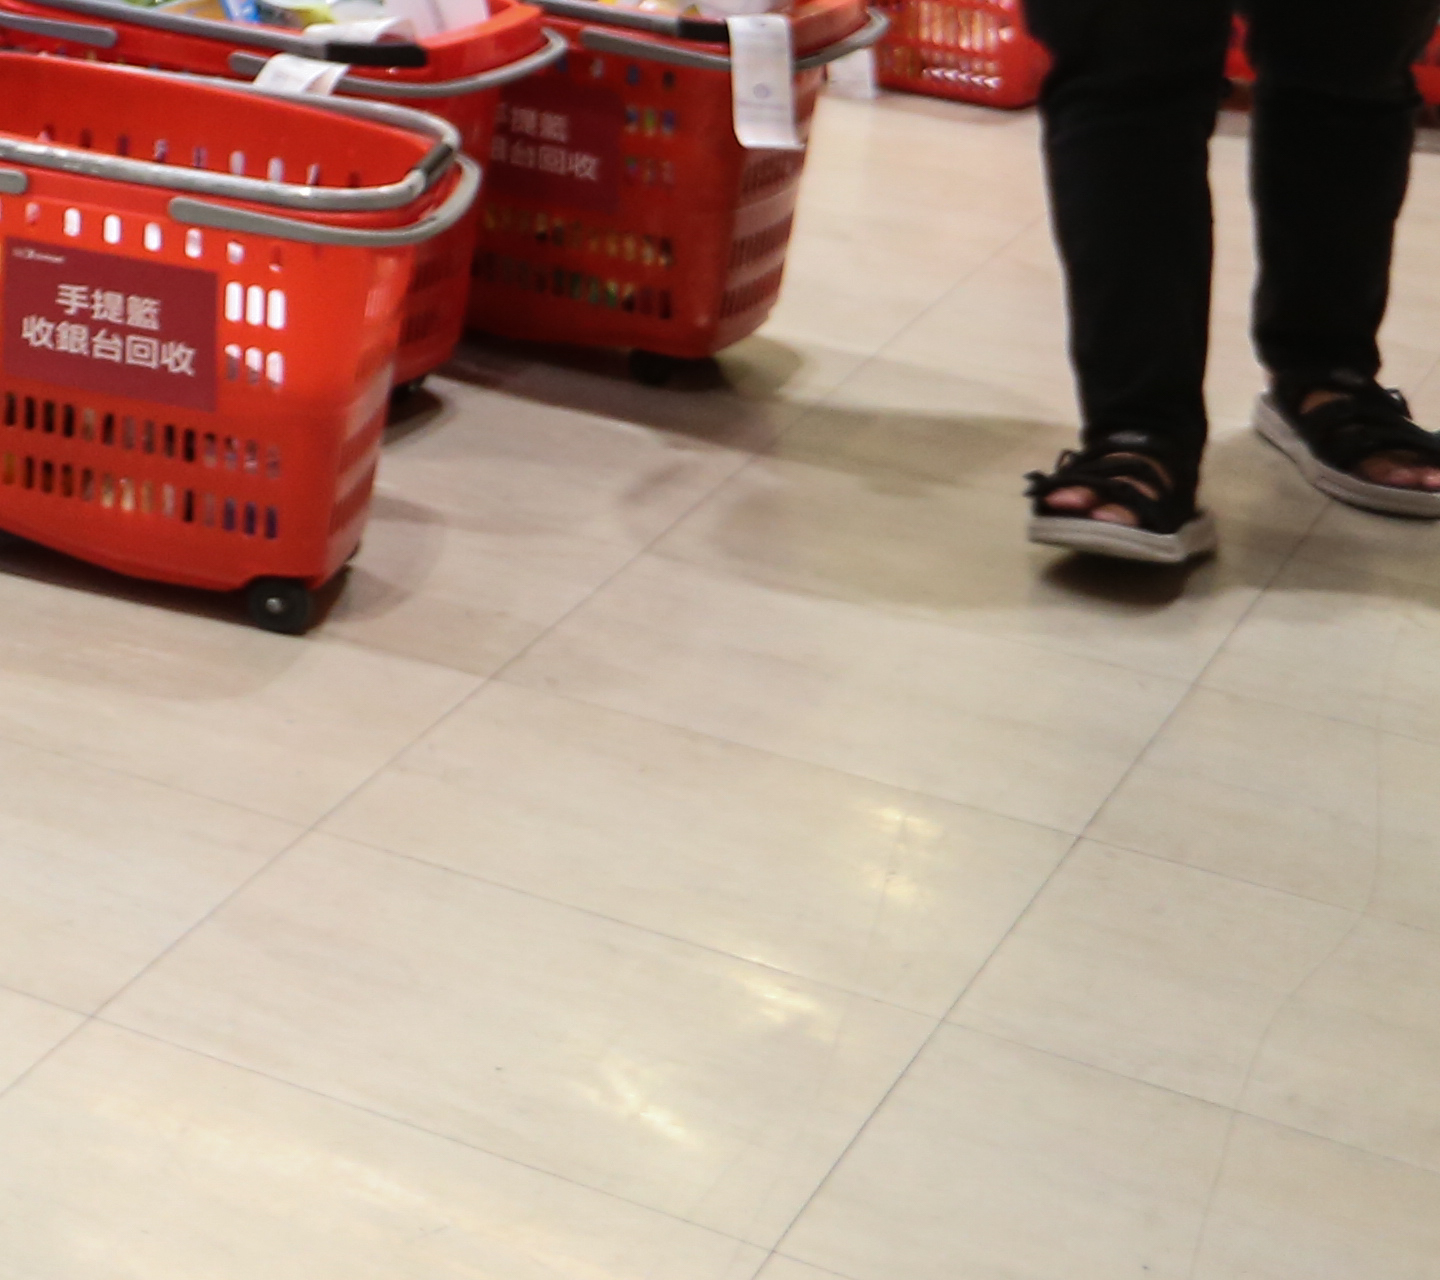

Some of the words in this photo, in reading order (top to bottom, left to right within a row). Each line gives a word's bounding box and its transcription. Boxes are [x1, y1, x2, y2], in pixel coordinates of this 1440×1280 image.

[55, 282, 161, 331] 手提籃
[22, 313, 197, 379] 收銀台回收
